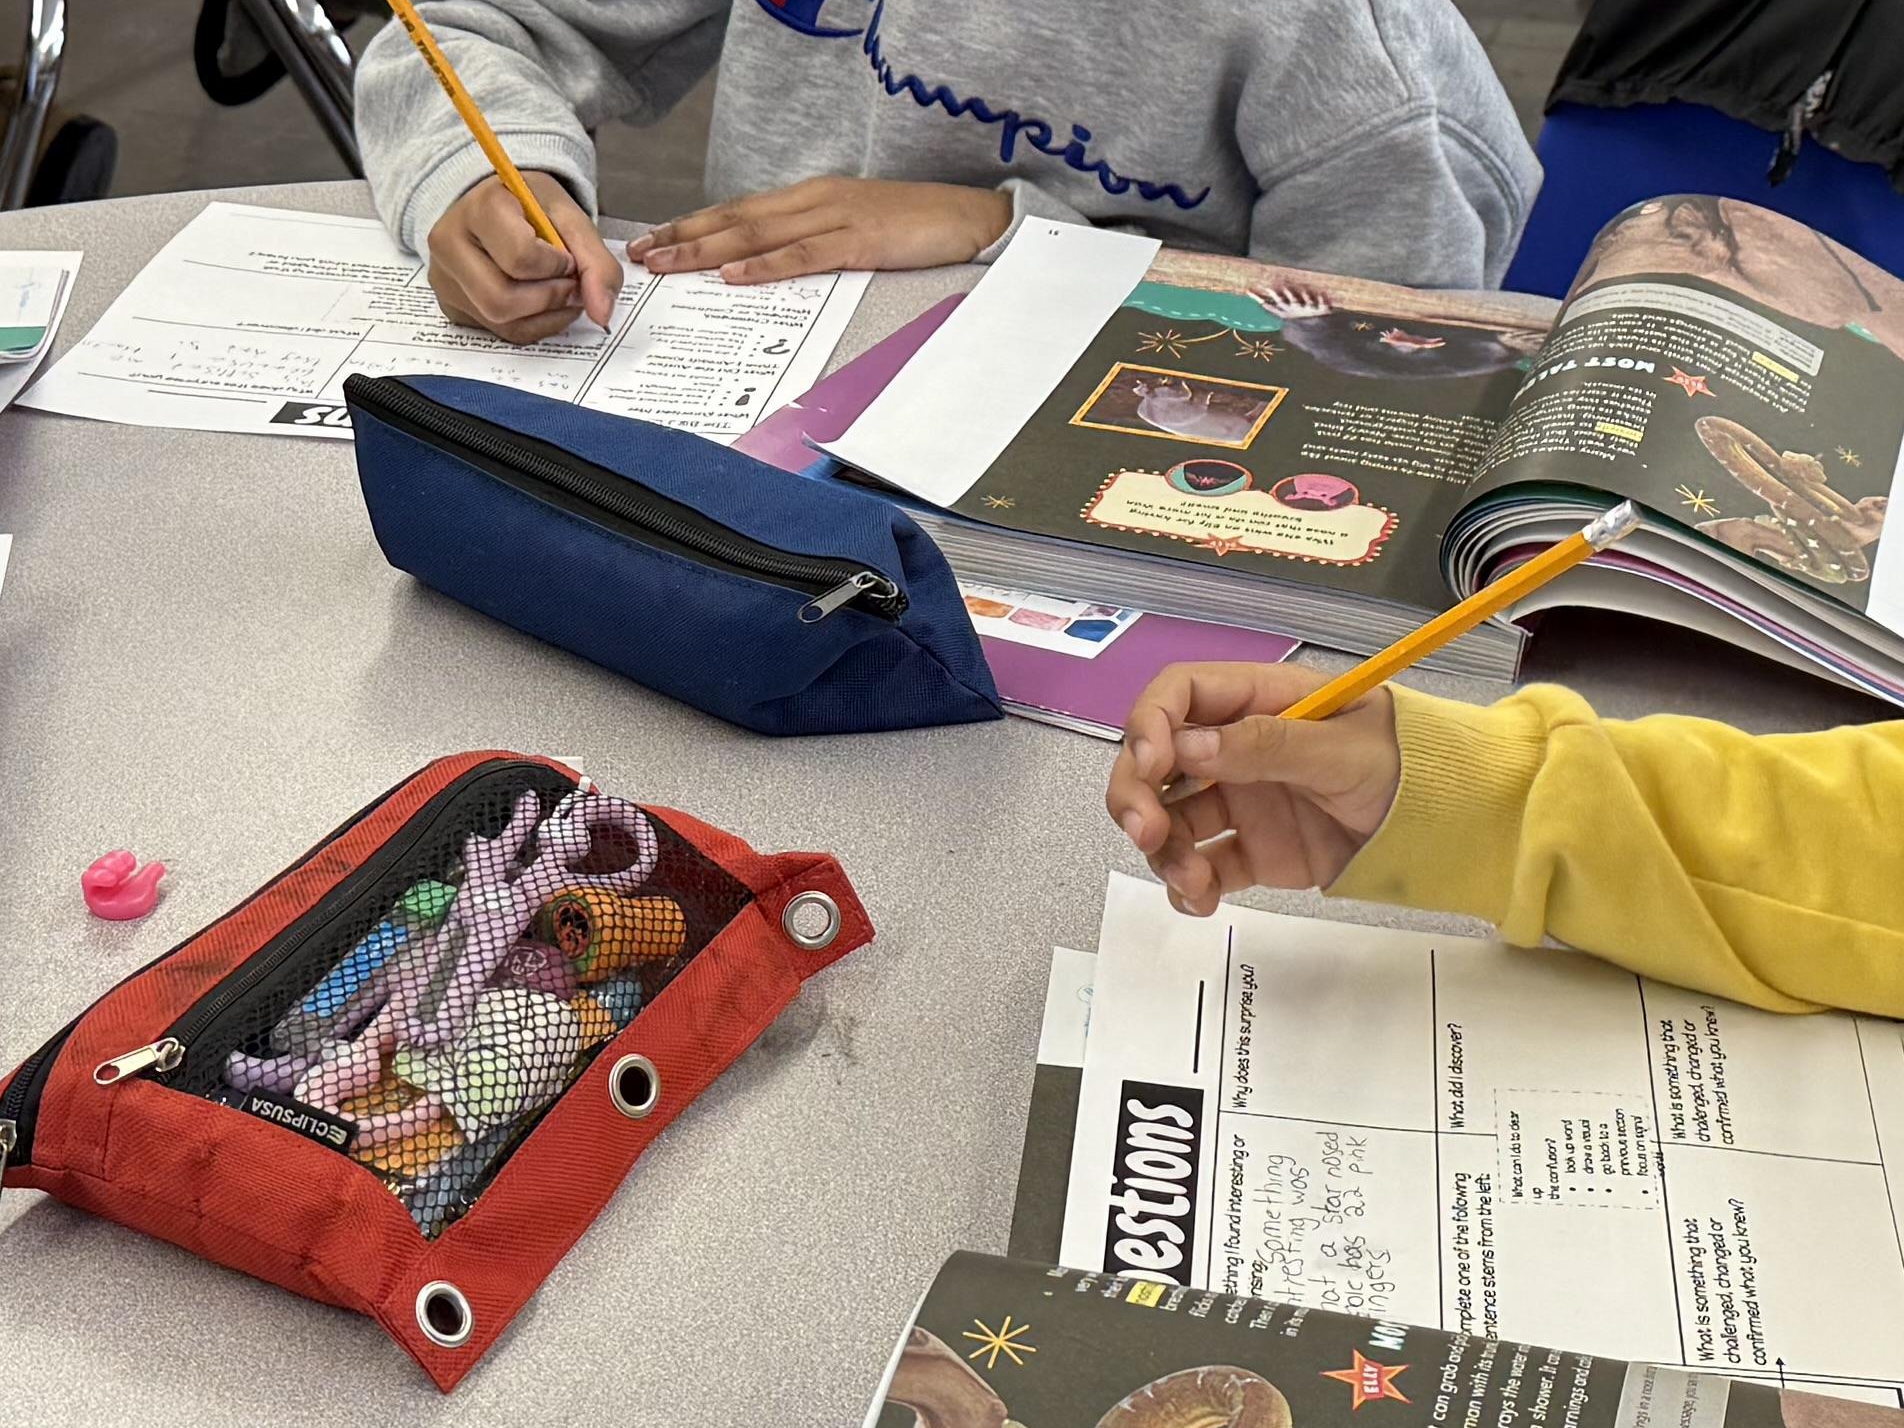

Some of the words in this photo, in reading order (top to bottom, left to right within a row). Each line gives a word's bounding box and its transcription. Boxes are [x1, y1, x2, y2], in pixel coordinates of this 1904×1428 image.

[1584, 356, 1657, 375] MOST
[1239, 962, 1258, 990] you?
[1239, 990, 1255, 1034] surprise
[1683, 1018, 1697, 1032] or
[1702, 1004, 1726, 1040] knew?
[1234, 1034, 1251, 1056] this
[1659, 1018, 1675, 1042] that
[1446, 1022, 1463, 1074] discover?
[1681, 1028, 1706, 1080] changed
[1709, 1037, 1727, 1060] you
[1233, 1056, 1250, 1084] does
[1663, 1042, 1682, 1100] something
[1709, 1061, 1725, 1088] what
[1231, 1084, 1253, 1108] Why
[1447, 1079, 1464, 1098] did
[251, 1098, 346, 1144] ECLIPSUSA
[1448, 1099, 1465, 1128] What
[1670, 1101, 1684, 1111] is
[1688, 1082, 1715, 1142] challenged,
[1707, 1089, 1734, 1145] confirmed
[1232, 1132, 1246, 1148] or
[1669, 1112, 1686, 1139] What
[1315, 1130, 1344, 1178] nosed
[1345, 1135, 1373, 1174] pink
[1110, 1098, 1194, 1287] estions
[1229, 1149, 1249, 1212] interesting
[1289, 1162, 1310, 1205] was
[1474, 1172, 1492, 1194] left:
[1252, 1153, 1297, 1266] Something
[1320, 1182, 1347, 1225] star
[1341, 1186, 1366, 1217] 22
[1451, 1171, 1472, 1222] following
[1476, 1194, 1493, 1216] the
[1223, 1212, 1241, 1249] found
[1476, 1216, 1494, 1247] from
[1683, 1217, 1700, 1244] that
[1708, 1216, 1724, 1231] or
[1727, 1197, 1749, 1238] knew?
[1319, 1240, 1338, 1258] a
[1452, 1223, 1469, 1245] the
[1277, 1213, 1321, 1307] ntresting
[1335, 1235, 1368, 1270] has
[1452, 1245, 1471, 1260] of
[1710, 1232, 1735, 1288] changed
[1737, 1238, 1758, 1264] you
[1217, 1255, 1244, 1297] ething
[1457, 1261, 1471, 1286] one
[1481, 1248, 1496, 1287] stems
[1688, 1245, 1710, 1312] something
[1739, 1265, 1757, 1298] what
[1451, 1287, 1476, 1338] omplete
[1472, 1289, 1498, 1341] entence
[1694, 1313, 1711, 1326] is
[1719, 1291, 1747, 1363] challenged,
[1696, 1327, 1714, 1361] What
[1744, 1299, 1767, 1365] confirmed
[1447, 1342, 1465, 1363] and
[1472, 1354, 1494, 1372] its
[1362, 1363, 1379, 1393] ELLY
[1439, 1363, 1458, 1393] grab
[1468, 1371, 1489, 1397] with
[1537, 1364, 1557, 1377] It
[1571, 1366, 1590, 1386] and
[1499, 1377, 1521, 1398] the
[1527, 1375, 1554, 1420] shower.
[1432, 1394, 1450, 1421] can
